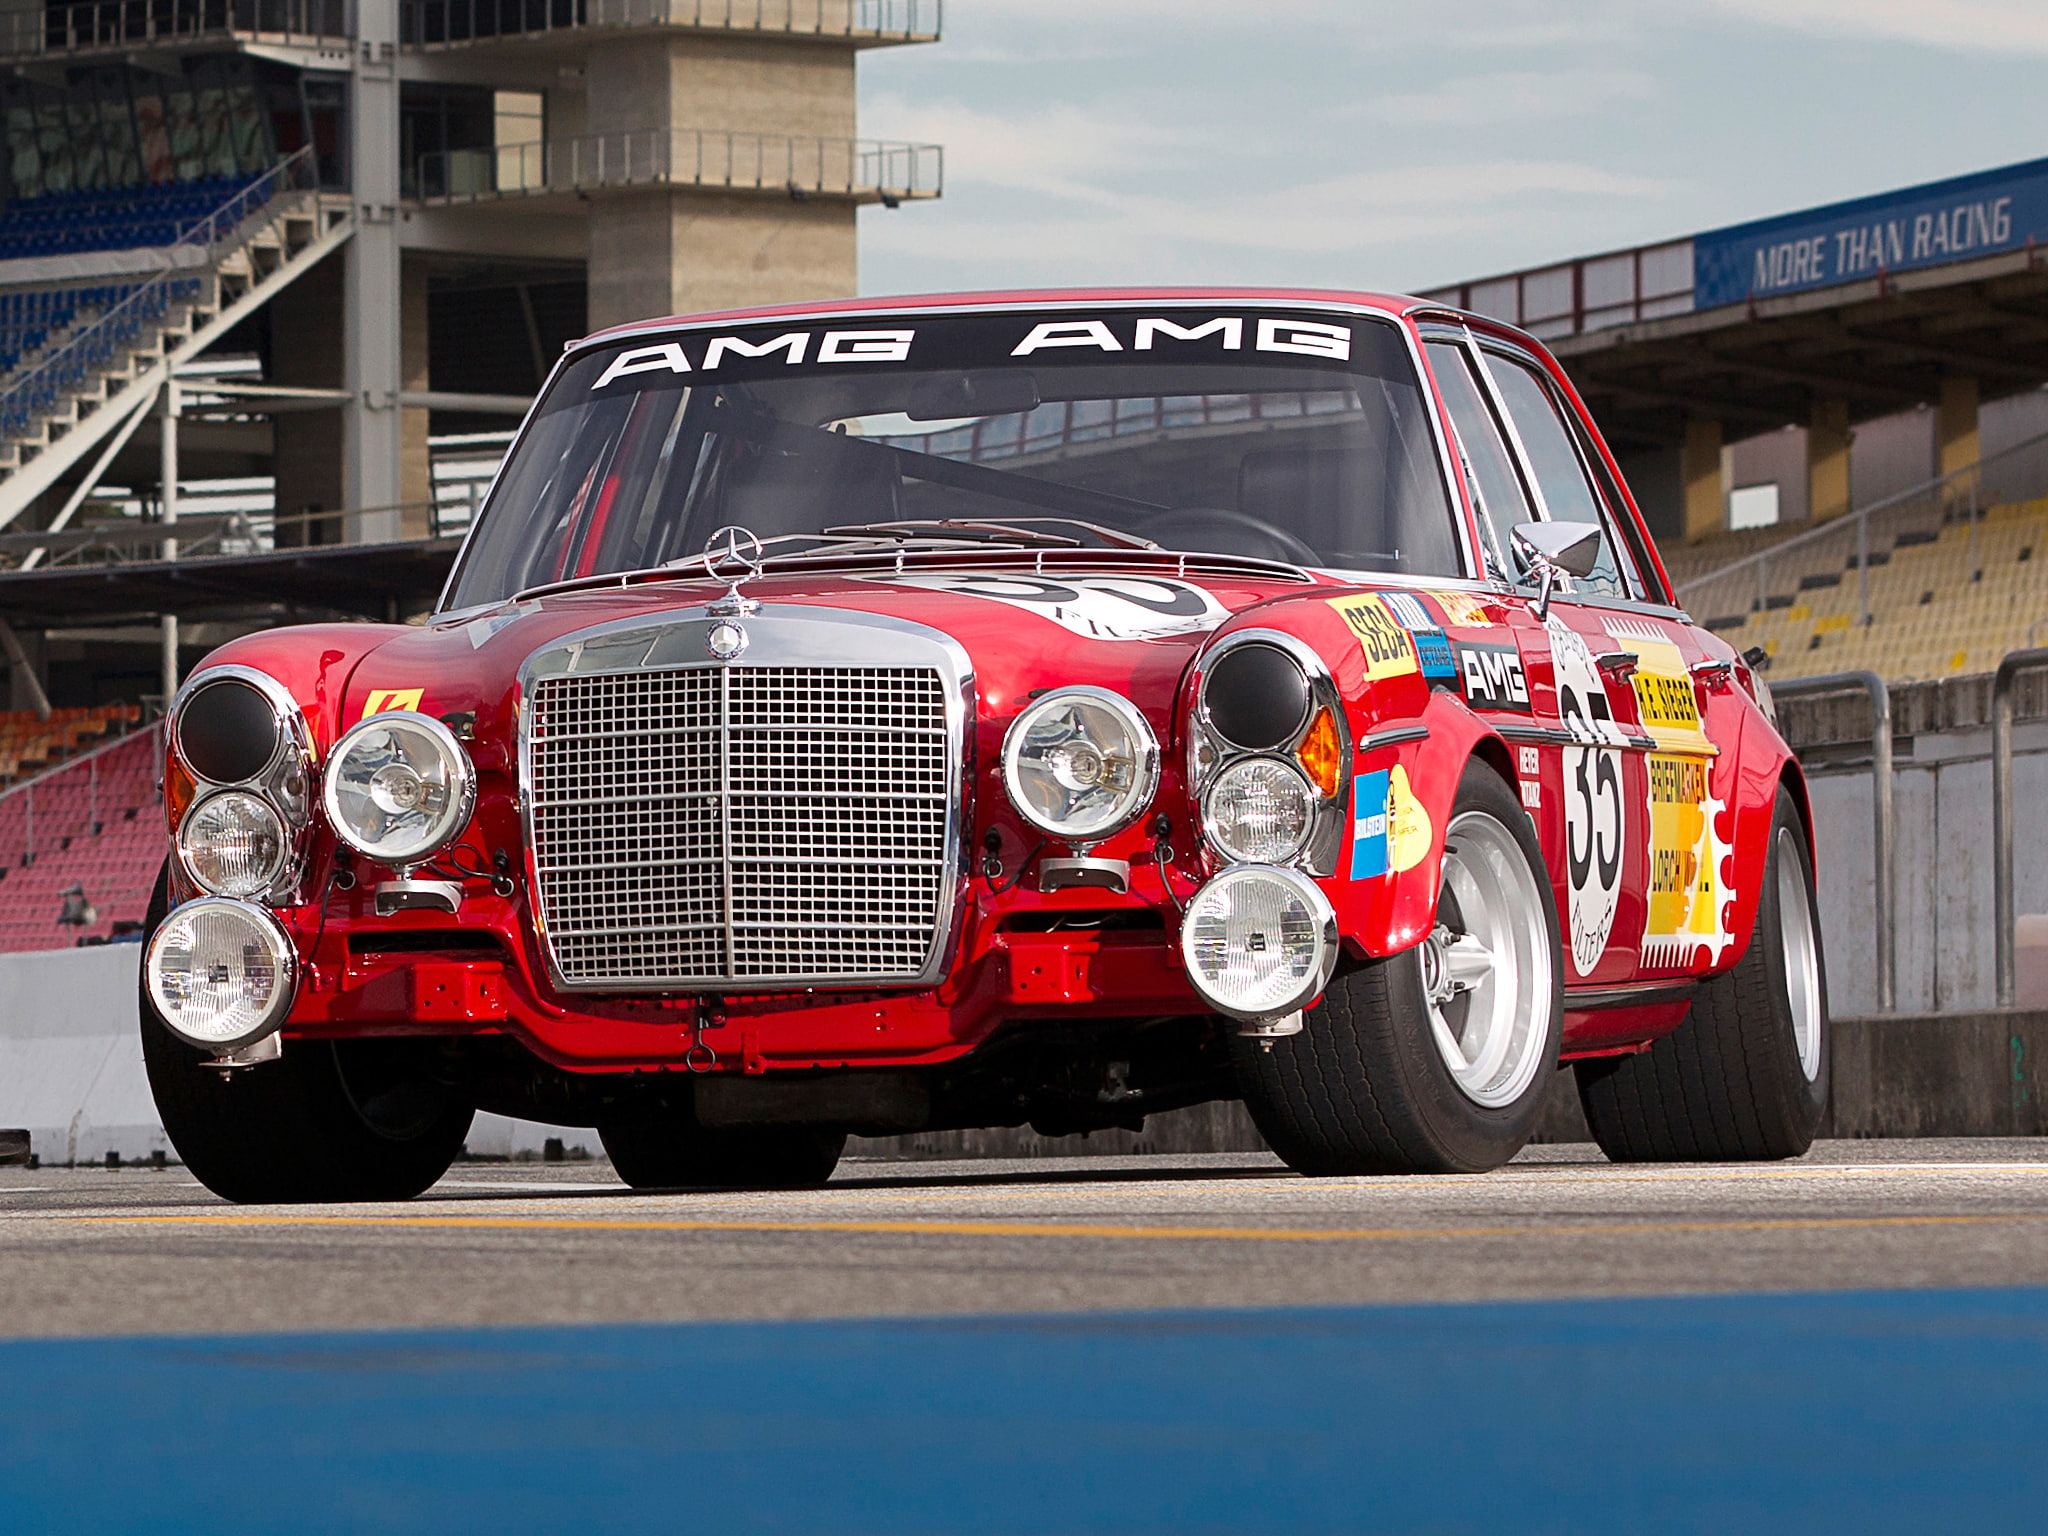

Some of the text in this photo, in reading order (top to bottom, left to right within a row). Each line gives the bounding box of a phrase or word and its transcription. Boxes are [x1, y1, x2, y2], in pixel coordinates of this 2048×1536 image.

[1753, 198, 2012, 290] MORE THAN RACING
[590, 329, 916, 391] AMG
[1010, 317, 1351, 361] AMG
[1460, 649, 1530, 703] AMG
[1656, 678, 1697, 721] SIEGER
[1561, 684, 1622, 891] 35
[1650, 759, 1706, 804] BRIEFMARKEN
[1572, 898, 1612, 966] FILTERS
